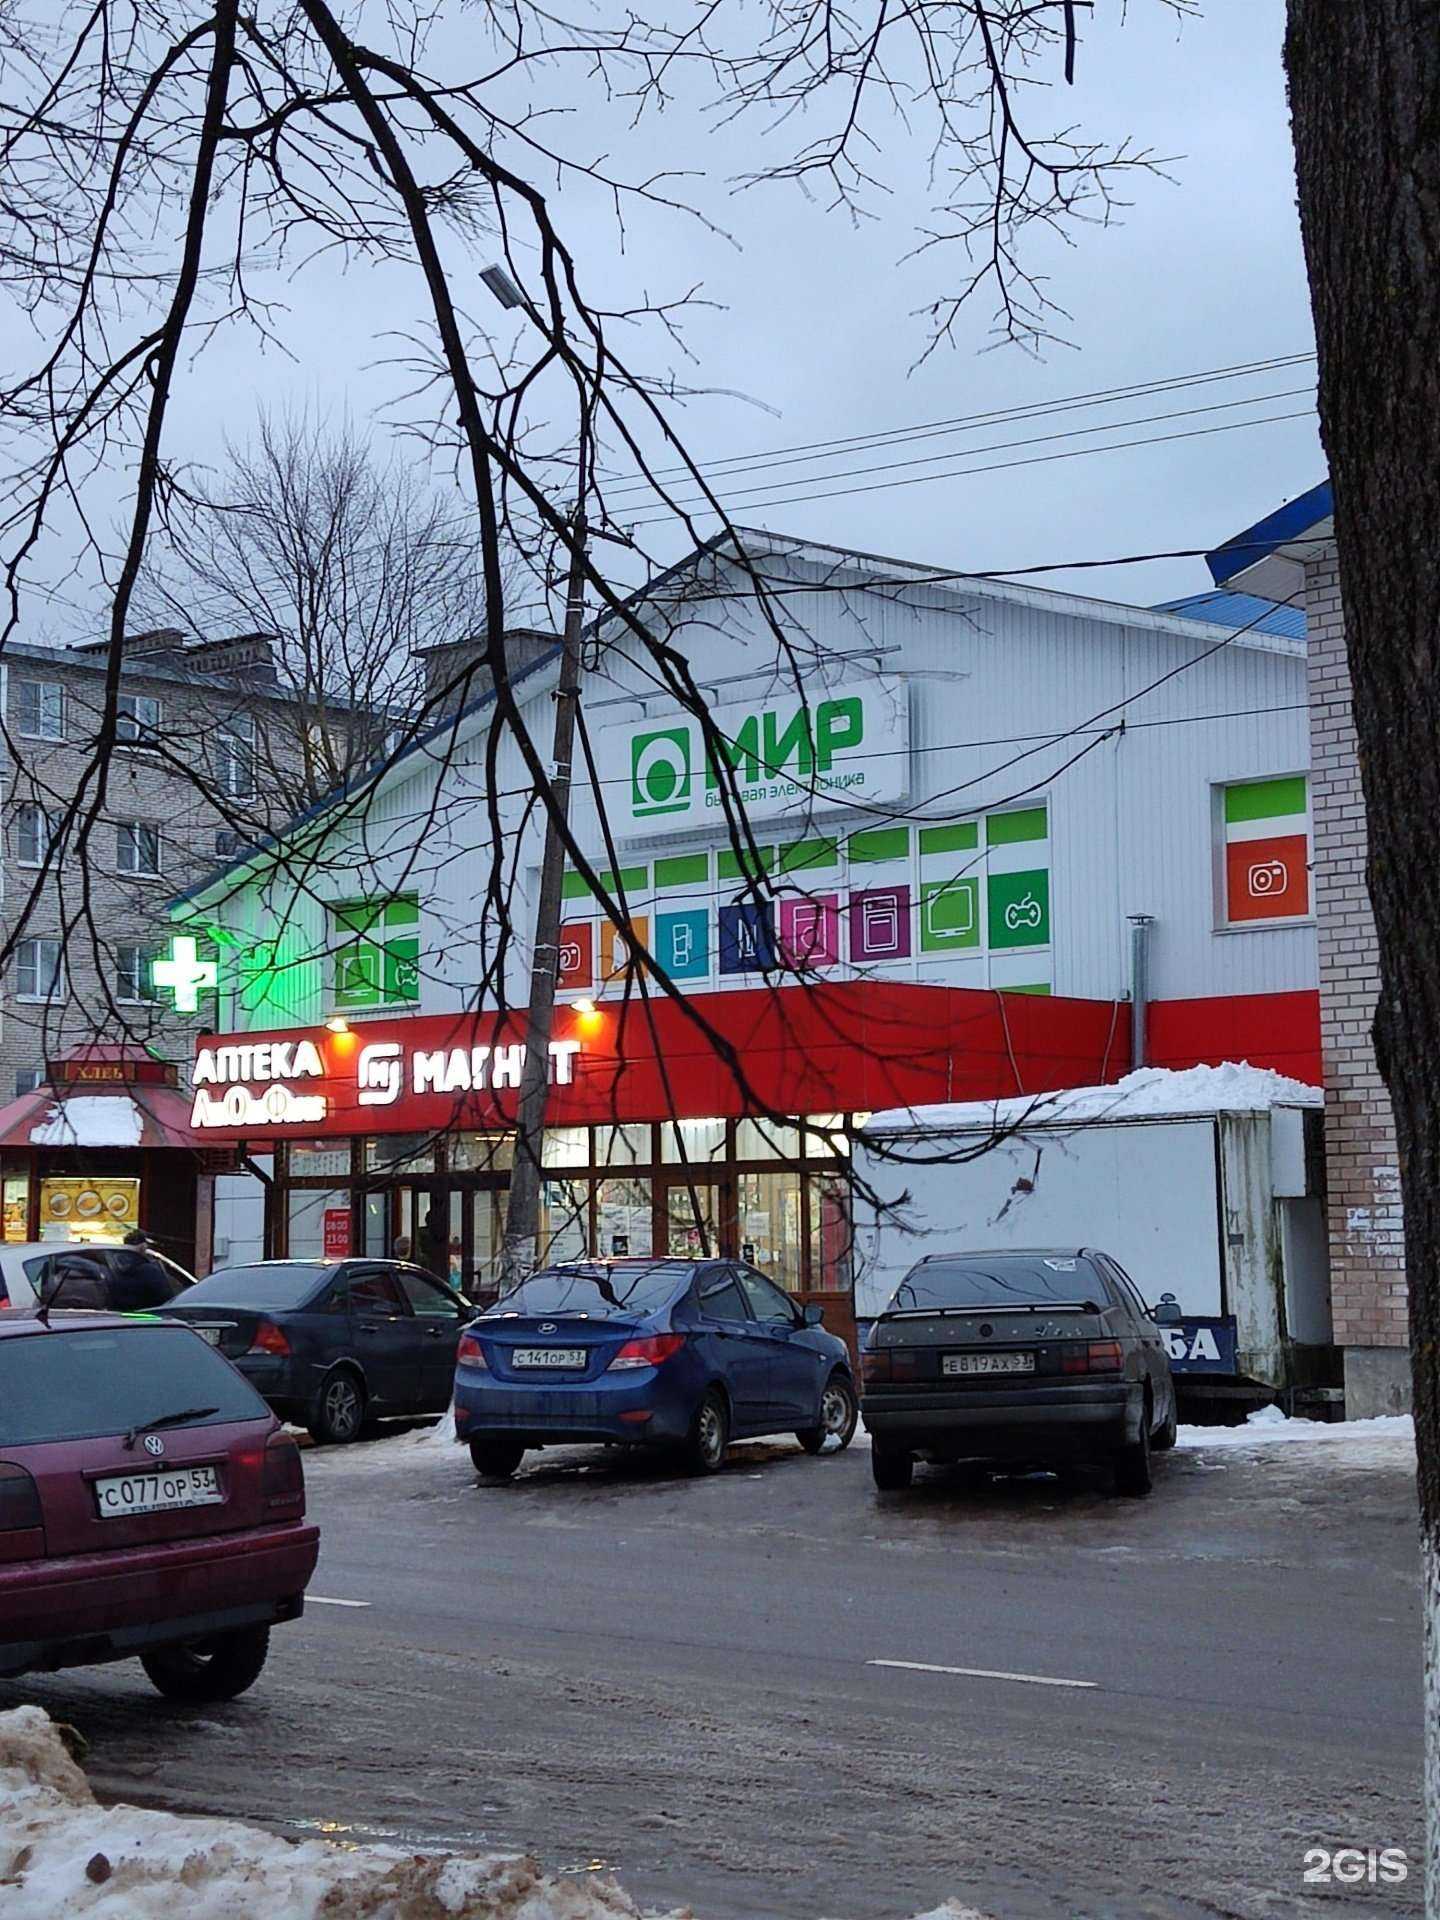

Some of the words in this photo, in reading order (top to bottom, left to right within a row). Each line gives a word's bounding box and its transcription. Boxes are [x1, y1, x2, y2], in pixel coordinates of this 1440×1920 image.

[705, 697, 864, 789] МИР
[705, 785, 767, 807] бывая
[192, 1040, 324, 1085] АПТЕКА
[412, 1040, 581, 1094] МАГНТ
